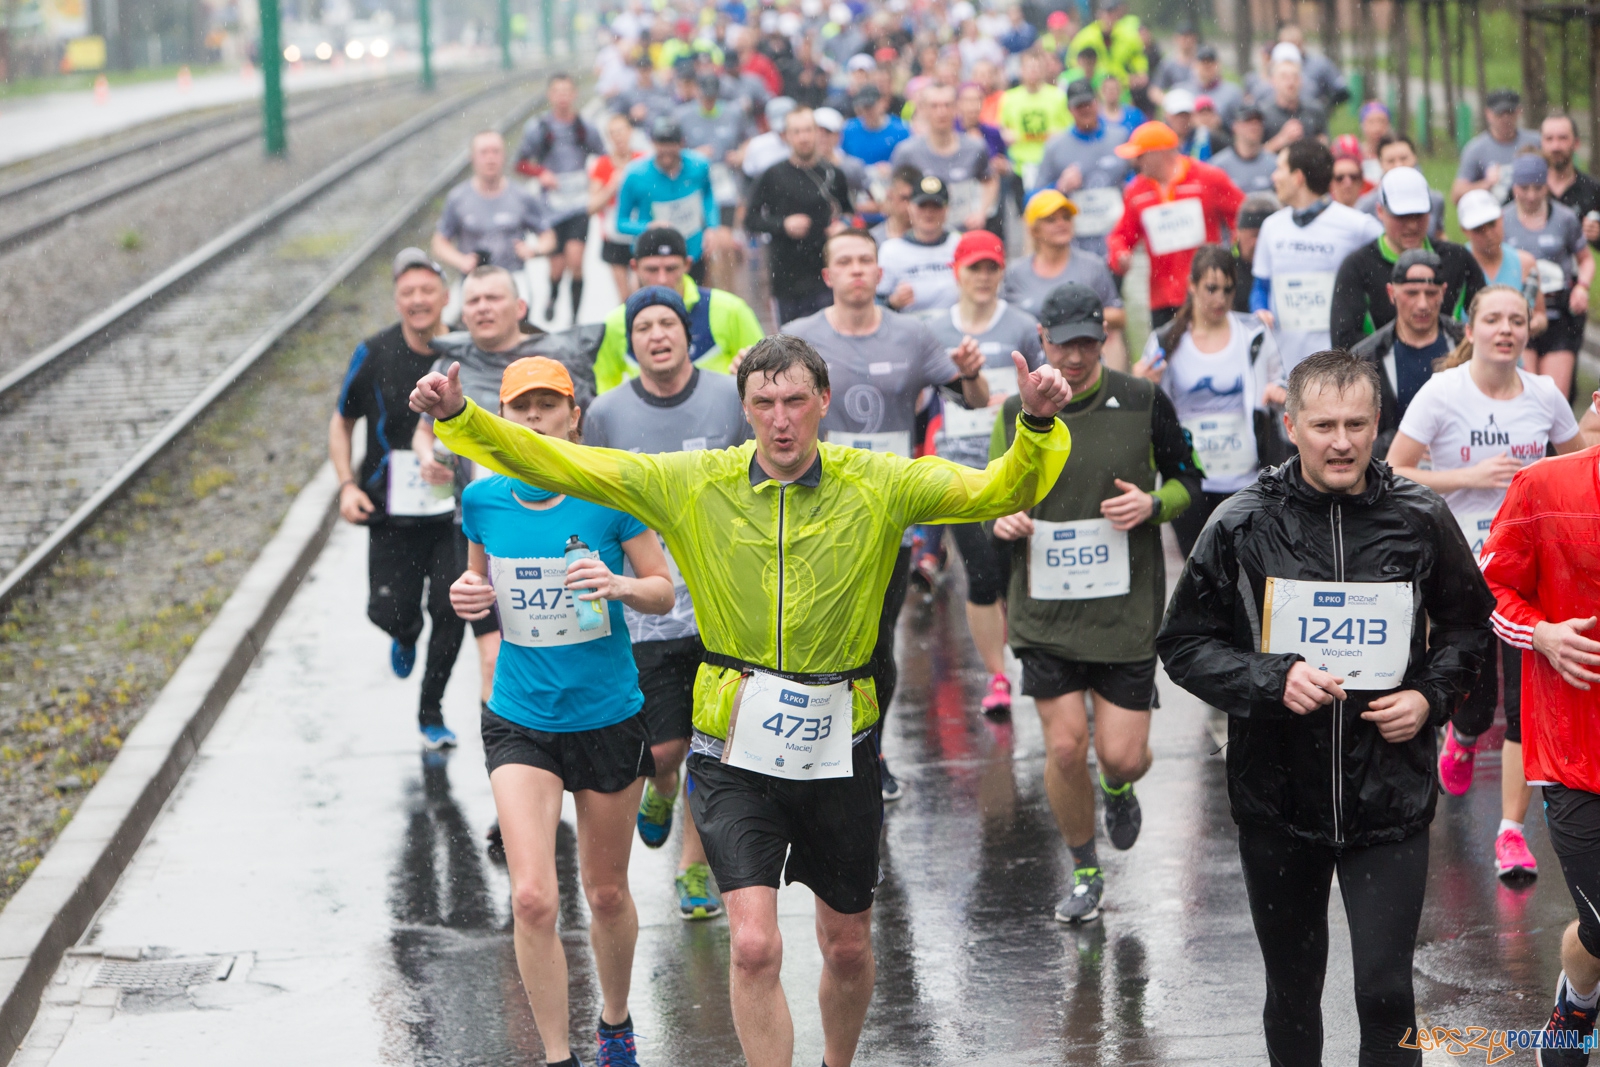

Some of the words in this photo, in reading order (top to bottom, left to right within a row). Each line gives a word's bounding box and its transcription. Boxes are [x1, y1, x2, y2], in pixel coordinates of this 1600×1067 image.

[1470, 430, 1510, 446] RUN
[1046, 544, 1109, 567] 6569
[529, 613, 567, 621] Katarzyna
[1298, 617, 1388, 645] 12413
[1321, 648, 1363, 658] Wojciech
[762, 712, 832, 741] 4733
[785, 742, 813, 754] Maciej
